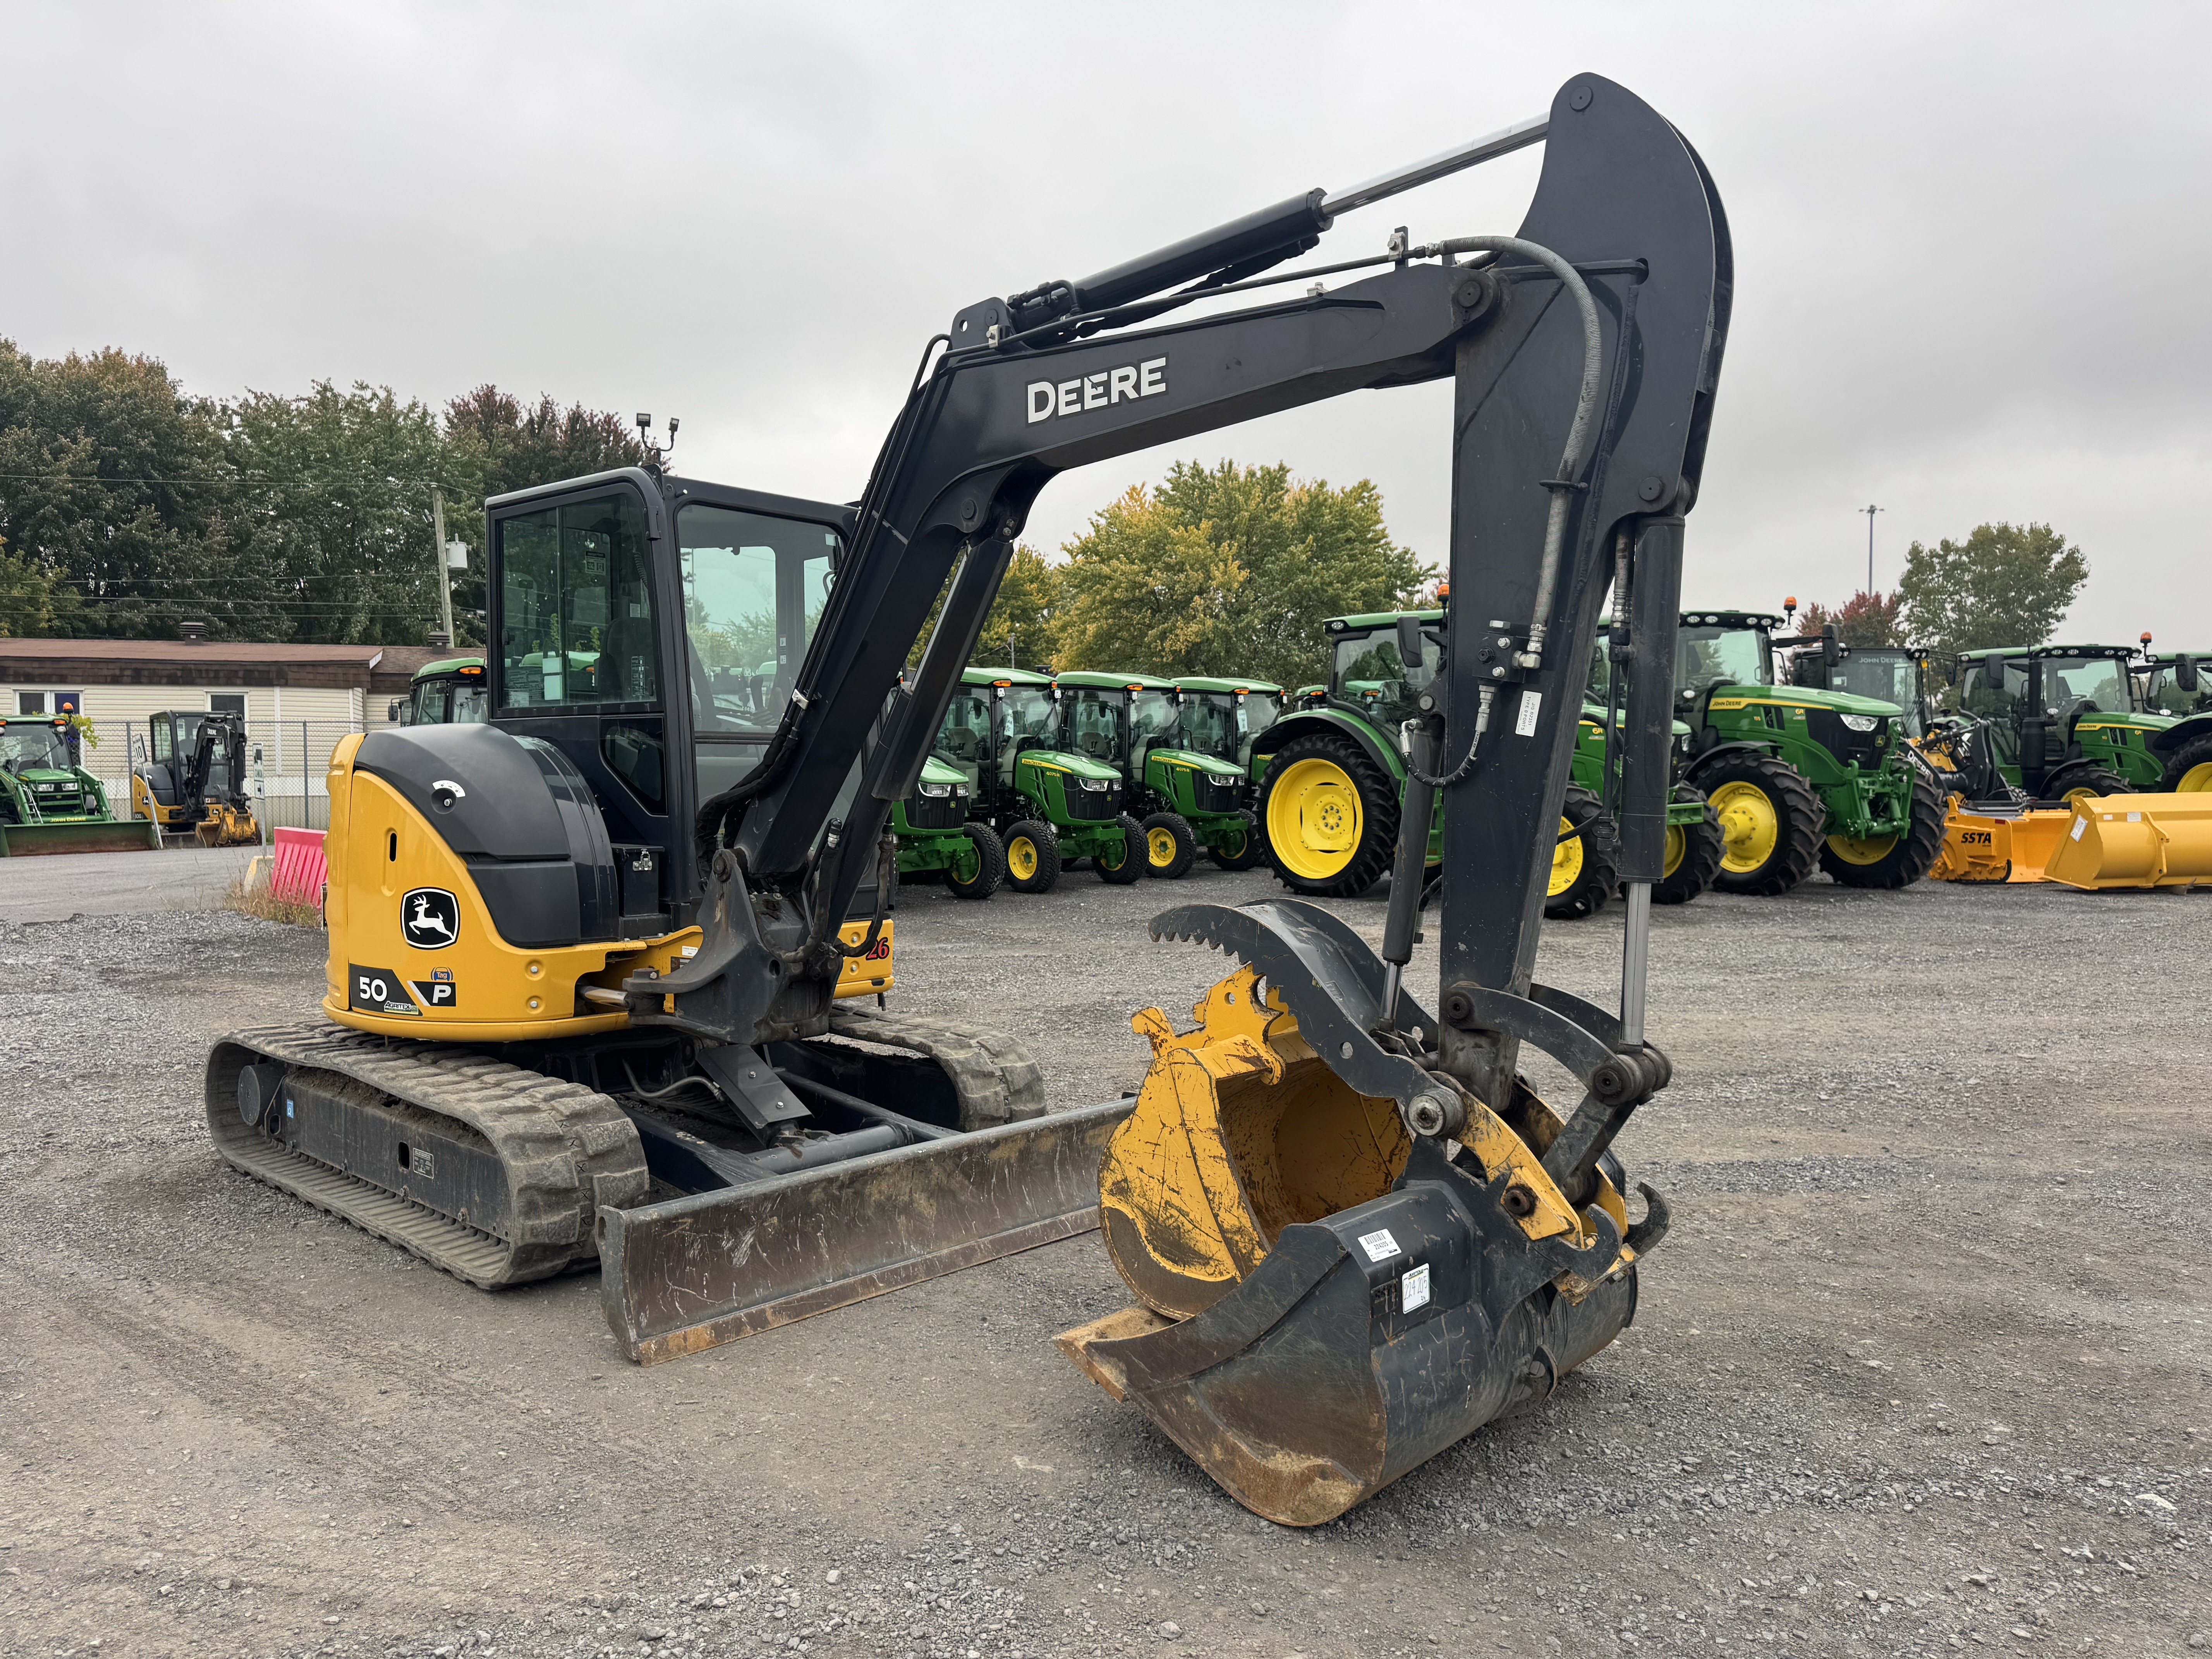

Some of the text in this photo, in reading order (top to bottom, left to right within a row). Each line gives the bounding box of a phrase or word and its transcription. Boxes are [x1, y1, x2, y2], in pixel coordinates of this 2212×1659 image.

[1027, 357, 1166, 423] DEERE
[135, 745, 143, 759] 10
[1961, 833, 1991, 844] SSTA
[359, 976, 387, 1002] 50
[432, 984, 452, 1003] P
[385, 1001, 410, 1010] AGRITEX
[1374, 1241, 1389, 1250] 224205
[1404, 1279, 1416, 1300] 224
